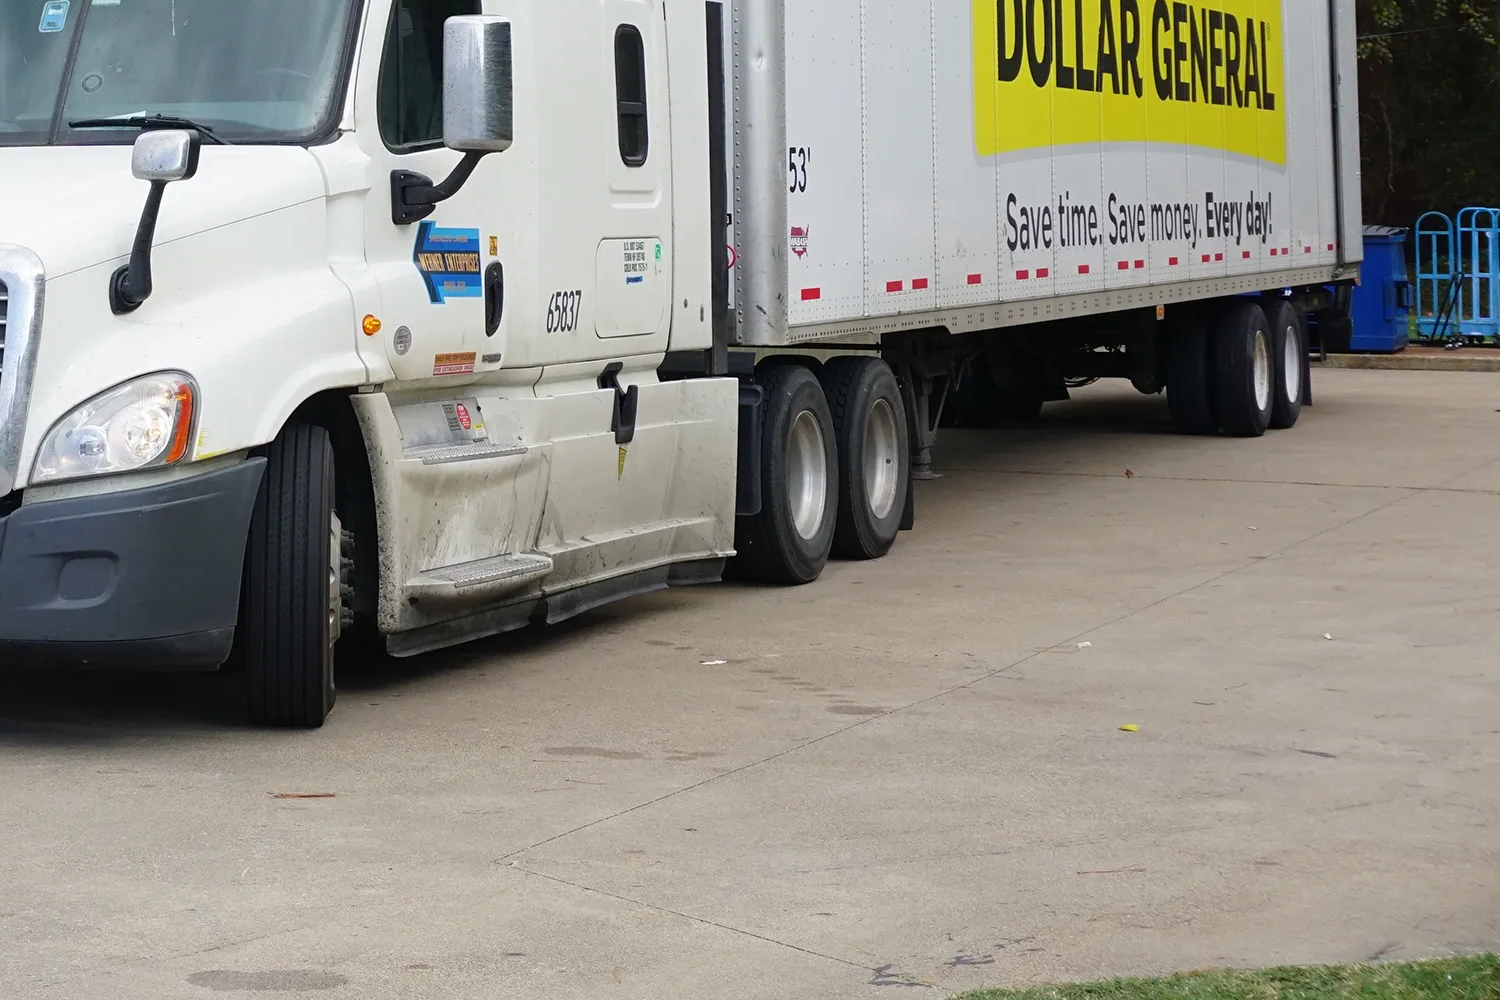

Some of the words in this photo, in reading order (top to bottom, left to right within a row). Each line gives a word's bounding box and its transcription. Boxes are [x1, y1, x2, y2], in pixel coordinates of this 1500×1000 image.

[789, 147, 810, 193] 53'
[1007, 193, 1052, 251] Save
[1058, 190, 1102, 247] time.
[1108, 193, 1145, 245] Save
[1151, 202, 1202, 249] money.
[1205, 191, 1242, 246] Every
[1246, 190, 1273, 244] day!
[418, 253, 445, 271] WERNER
[445, 253, 479, 271] ENTERPRISES
[547, 290, 581, 333] 65837
